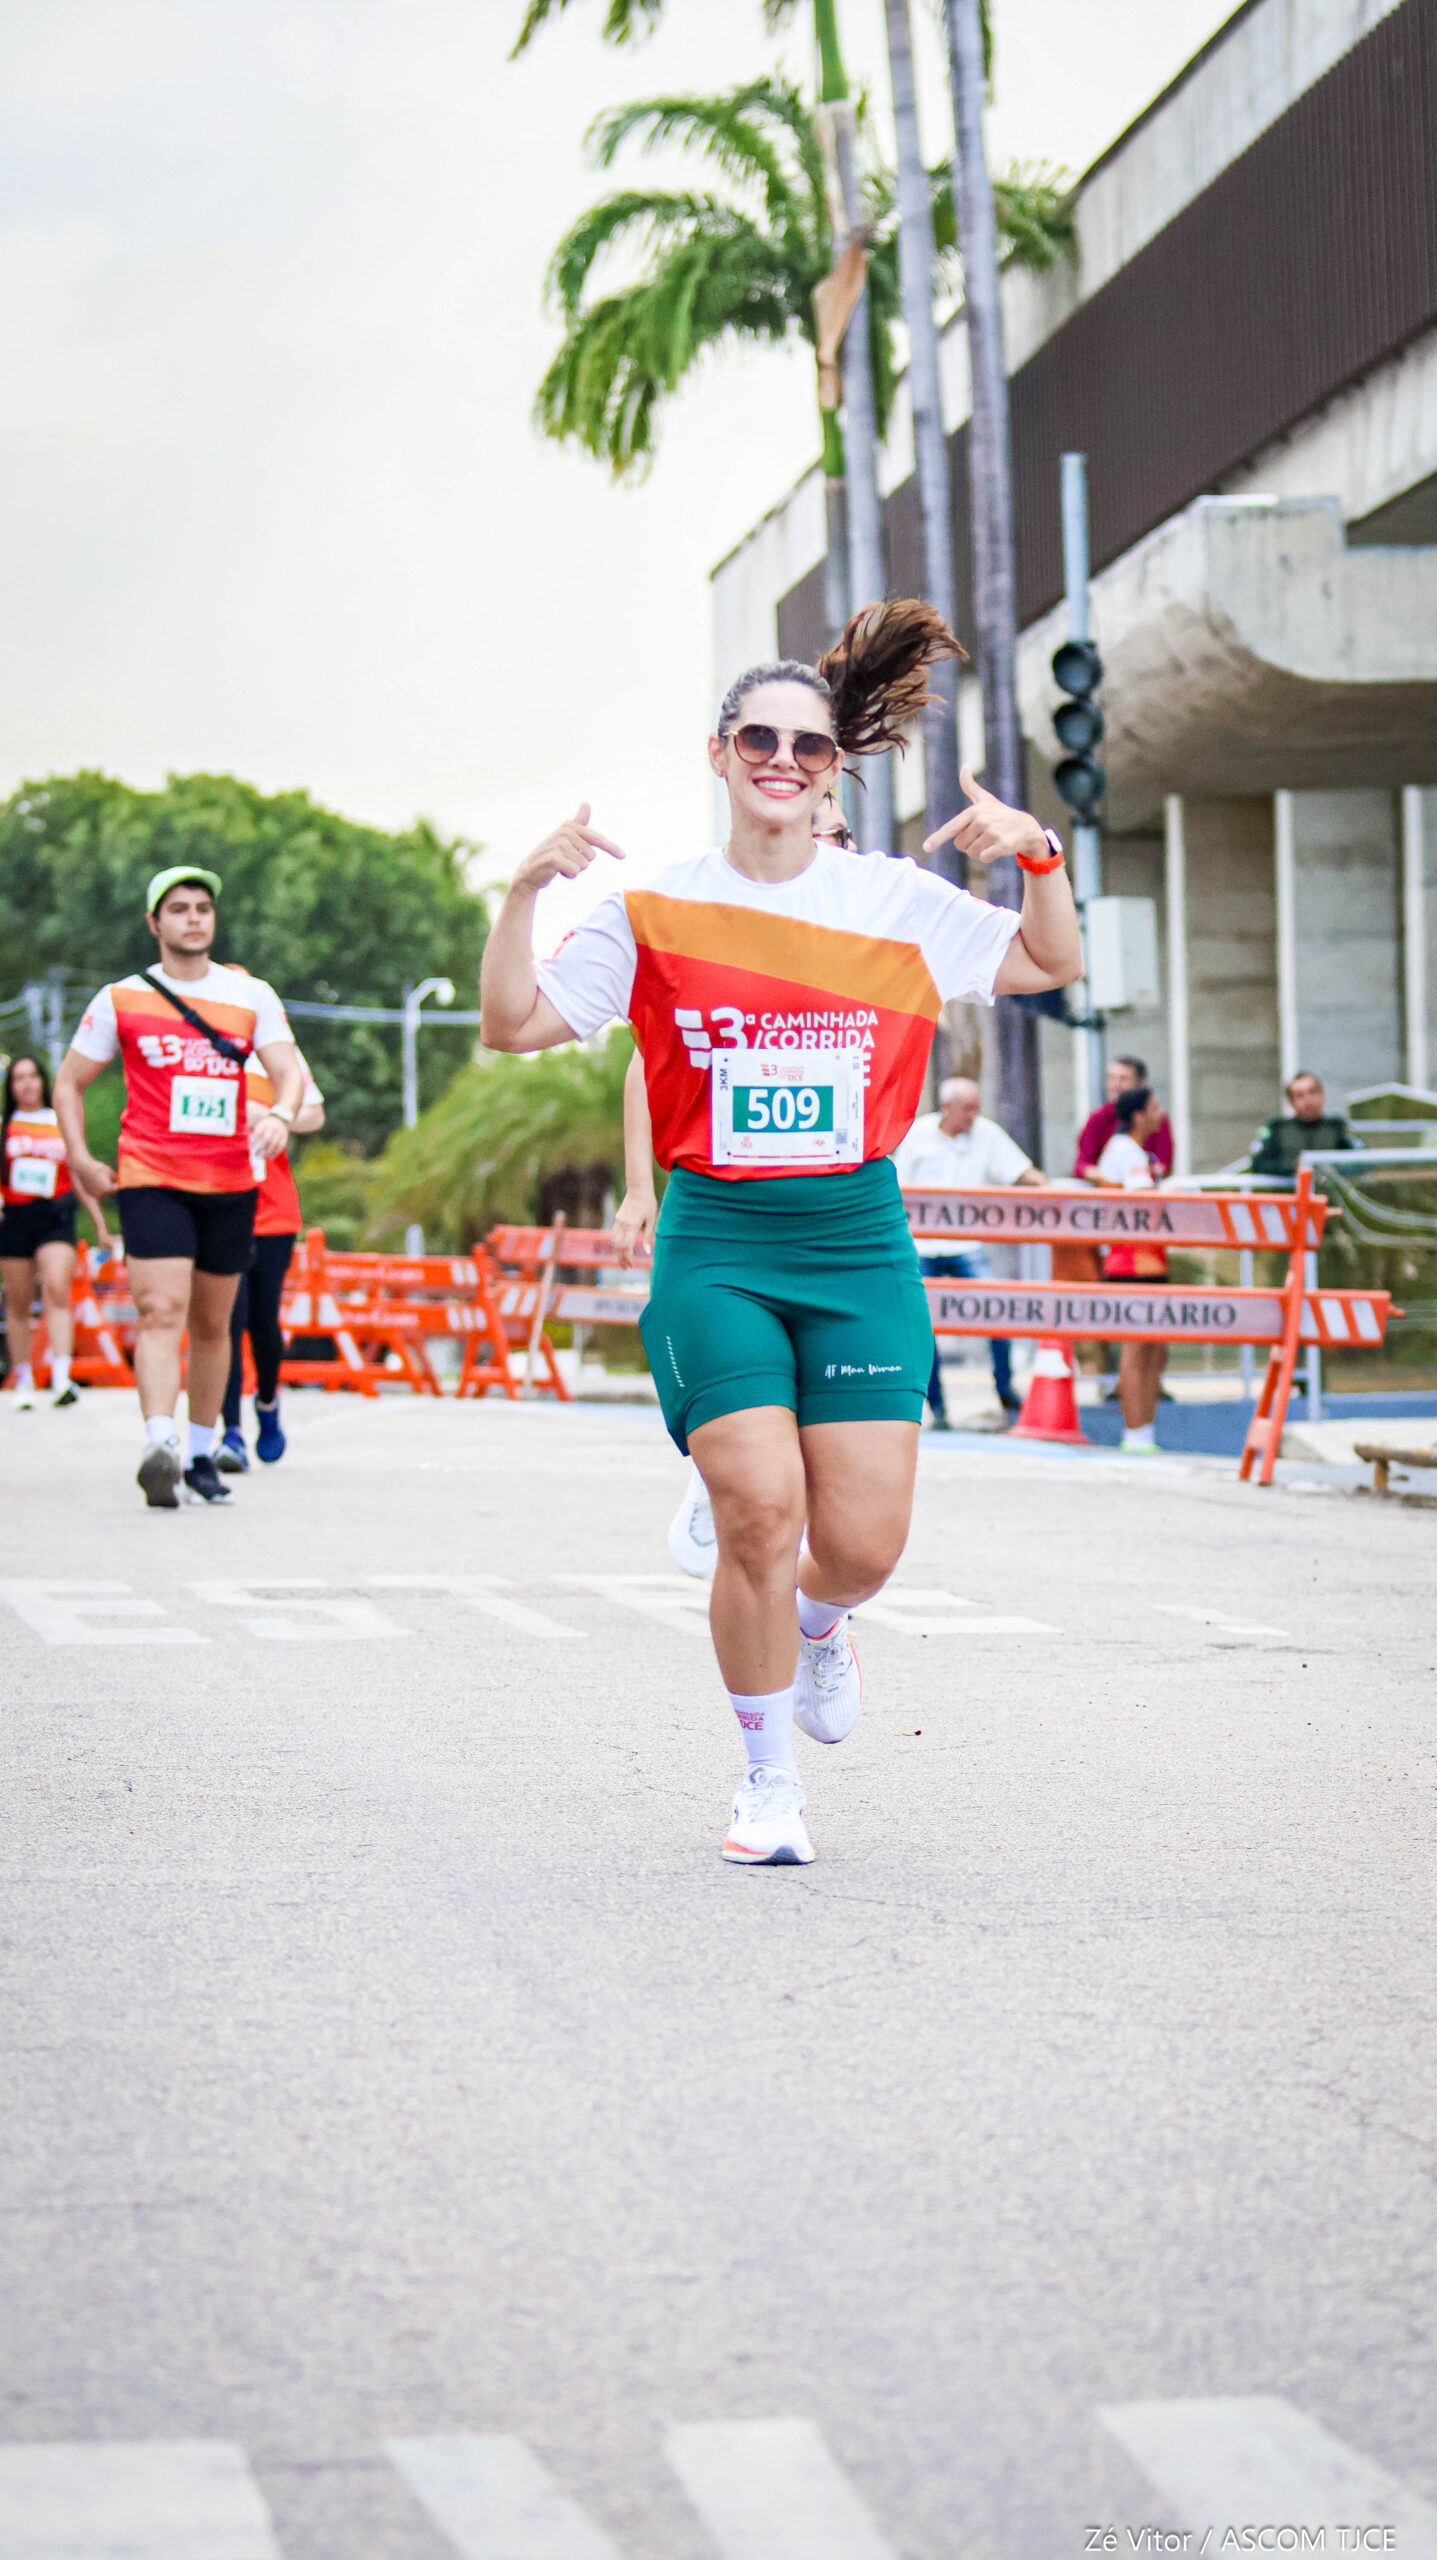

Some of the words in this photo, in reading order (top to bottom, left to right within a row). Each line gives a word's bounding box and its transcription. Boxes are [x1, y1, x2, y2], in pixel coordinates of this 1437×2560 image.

[761, 1009, 878, 1029] CAMINHADA
[719, 1068, 728, 1091] 3KM
[747, 1088, 821, 1130] 509
[1014, 1205, 1061, 1230] DO
[1069, 1204, 1175, 1234] CEARÁ
[940, 1296, 1045, 1322] PODER
[1053, 1297, 1237, 1329] JUDICIÁRIO
